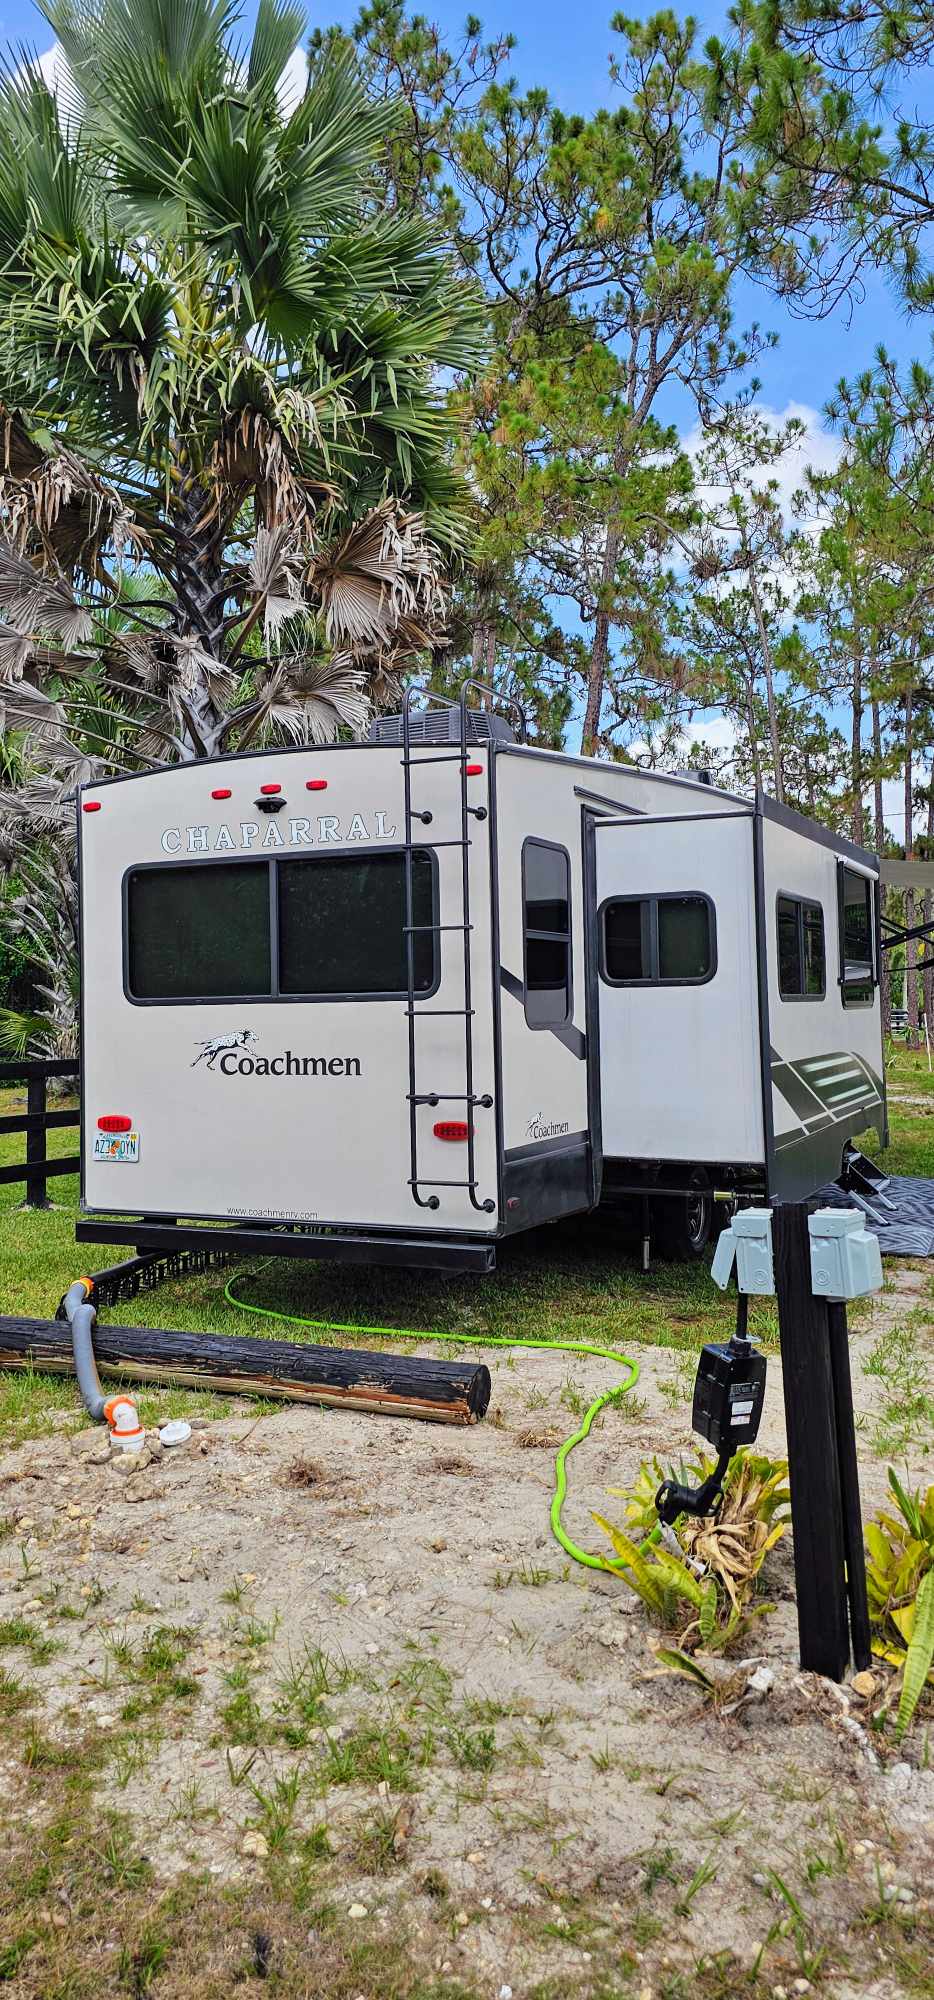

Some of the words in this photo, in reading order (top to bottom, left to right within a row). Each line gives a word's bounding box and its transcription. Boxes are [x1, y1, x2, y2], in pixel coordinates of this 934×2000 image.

[161, 811, 396, 854] CHAPARRAL
[220, 1051, 362, 1076] Coachmen
[533, 1121, 569, 1139] Coachmen
[226, 1207, 318, 1220] www.coachmenrv.com
